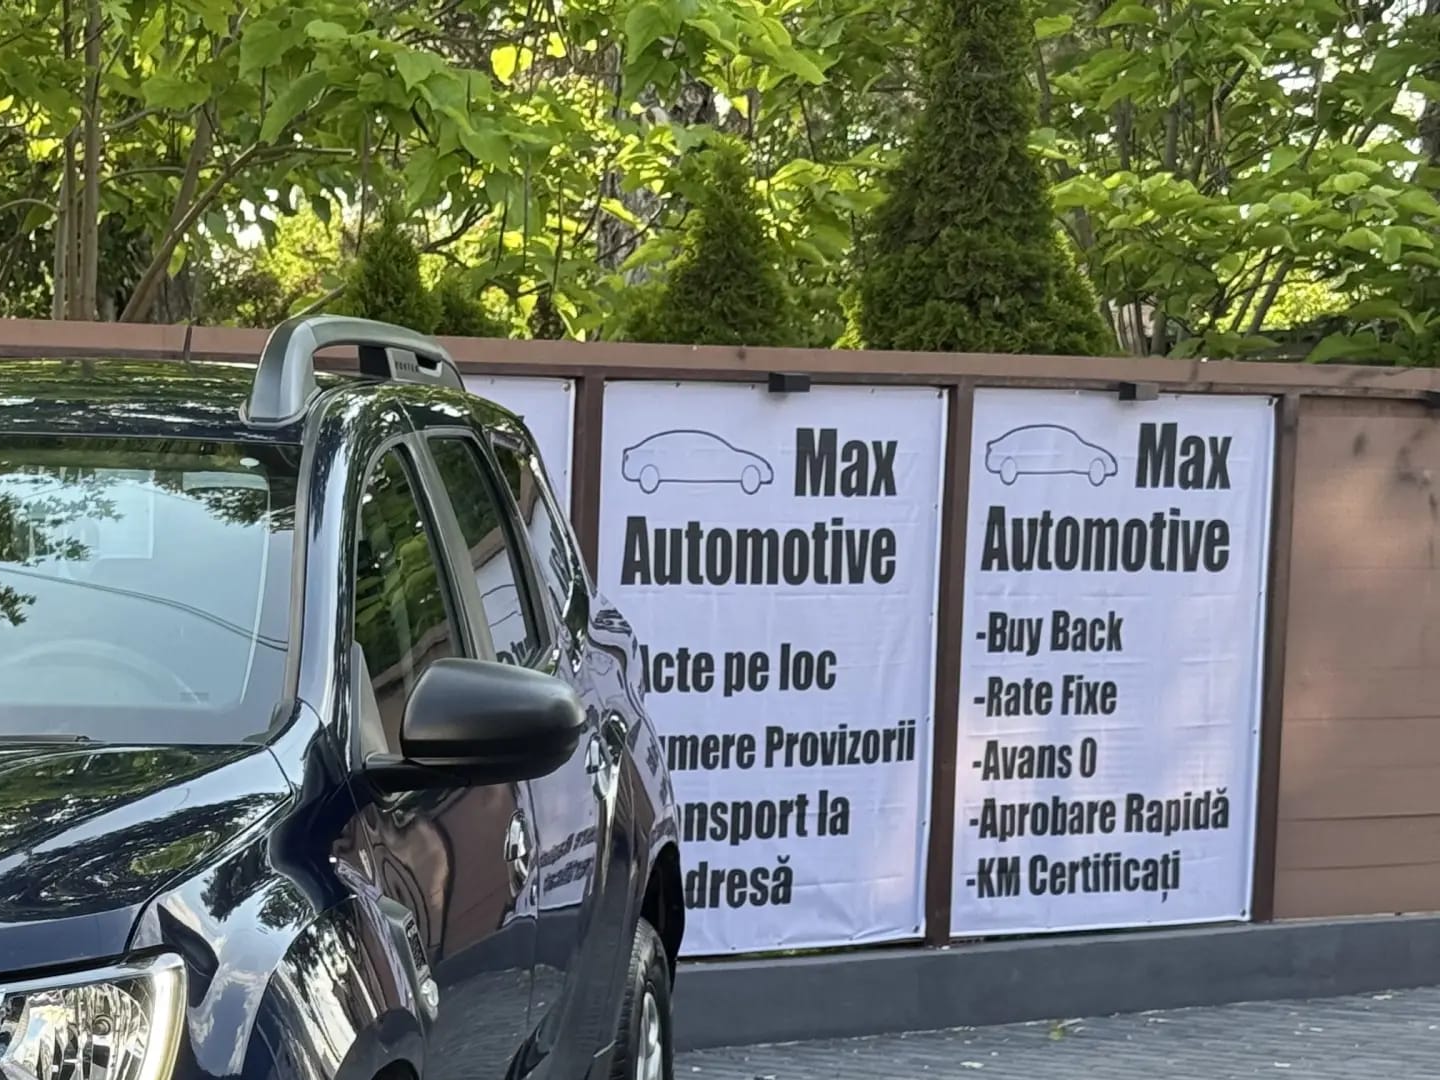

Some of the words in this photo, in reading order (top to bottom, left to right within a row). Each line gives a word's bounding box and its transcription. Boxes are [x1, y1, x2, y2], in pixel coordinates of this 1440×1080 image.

[794, 427, 898, 496] Max
[1135, 422, 1232, 490] Max
[621, 516, 897, 586] Automotive
[980, 505, 1231, 573] Automotive
[976, 611, 1043, 657] -Buy
[1050, 610, 1123, 651] Back
[723, 651, 769, 697] pe
[779, 643, 837, 691] loc
[973, 676, 1053, 717] -Rate
[1060, 675, 1117, 715] Fixe
[659, 732, 756, 771] mere
[764, 720, 916, 768] Provizorii
[972, 740, 1072, 781] -Avans
[676, 793, 810, 846] nsport
[817, 789, 850, 836] la
[969, 796, 1116, 842] -Aprobare
[1124, 787, 1229, 836] Rapidă
[685, 855, 793, 909] dresă
[966, 855, 1020, 898] -KM
